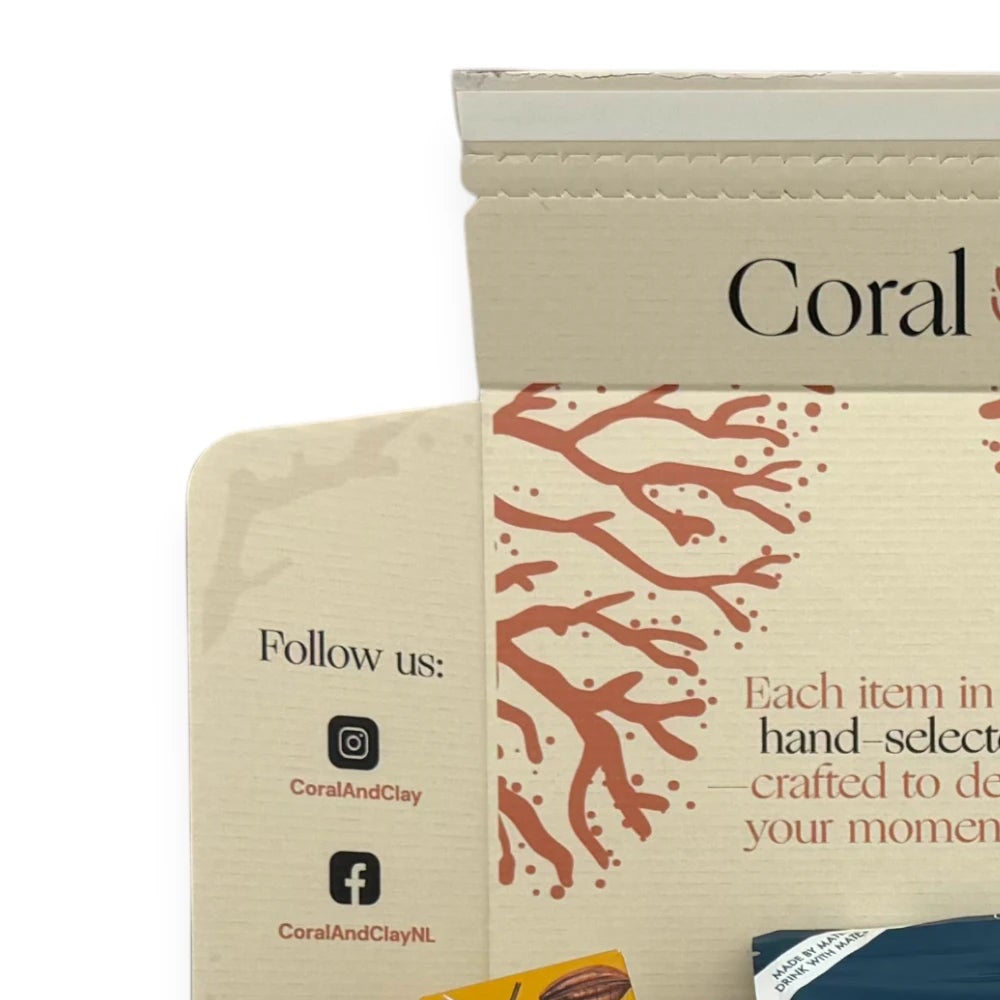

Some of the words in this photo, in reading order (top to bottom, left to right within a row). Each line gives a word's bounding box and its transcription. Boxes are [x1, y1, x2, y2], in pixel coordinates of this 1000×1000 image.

[728, 247, 971, 336] Coral
[258, 628, 383, 671] Follow
[395, 650, 445, 678] us:
[744, 672, 843, 710] Each
[859, 676, 944, 709] item
[960, 675, 994, 709] in
[290, 778, 422, 806] CoralAndClay
[902, 766, 940, 799] to
[742, 814, 833, 852] your
[278, 923, 436, 946] CoralAndClayNL
[772, 955, 804, 980] MADE
[802, 947, 817, 957] BY
[775, 964, 810, 992] DRINK
[807, 949, 836, 966] WITH
